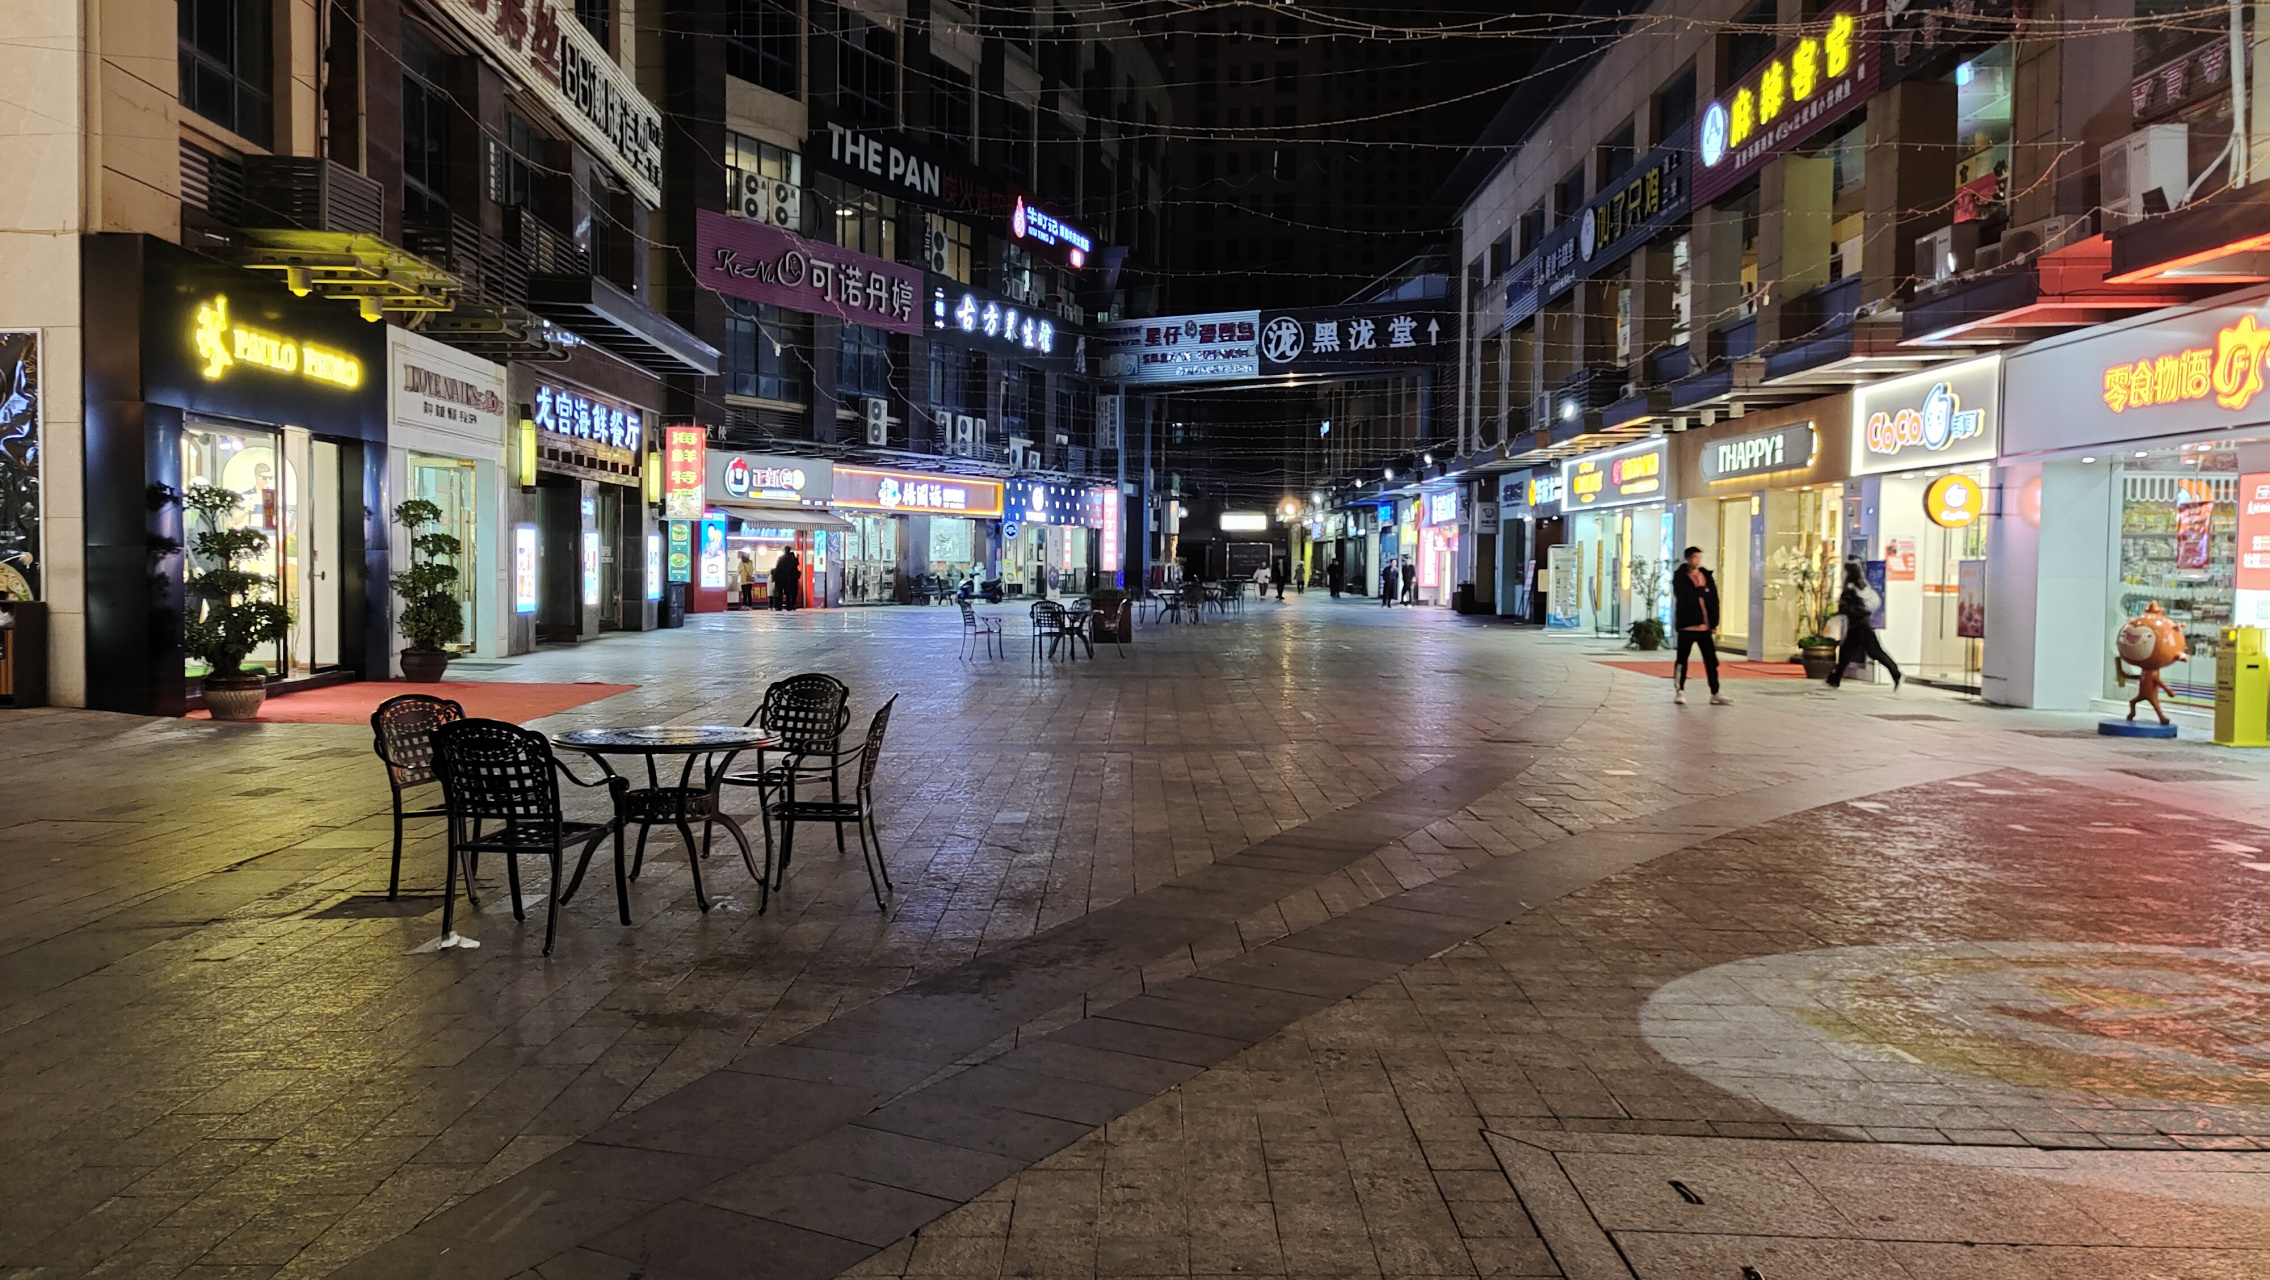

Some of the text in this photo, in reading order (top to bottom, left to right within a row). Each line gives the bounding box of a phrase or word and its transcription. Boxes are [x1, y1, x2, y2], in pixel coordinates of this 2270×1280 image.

[1730, 14, 1852, 148] 麻辣客官
[827, 120, 941, 198] THE PAN
[1597, 167, 1660, 249] 叫了只鸡
[809, 258, 914, 323] 可诺丹婷
[1312, 316, 1419, 354] 黑泷堂
[2103, 348, 2213, 413] 零食物语
[536, 386, 642, 452] 龙宫海鲜餐厅
[671, 431, 698, 501] 海鲜特产
